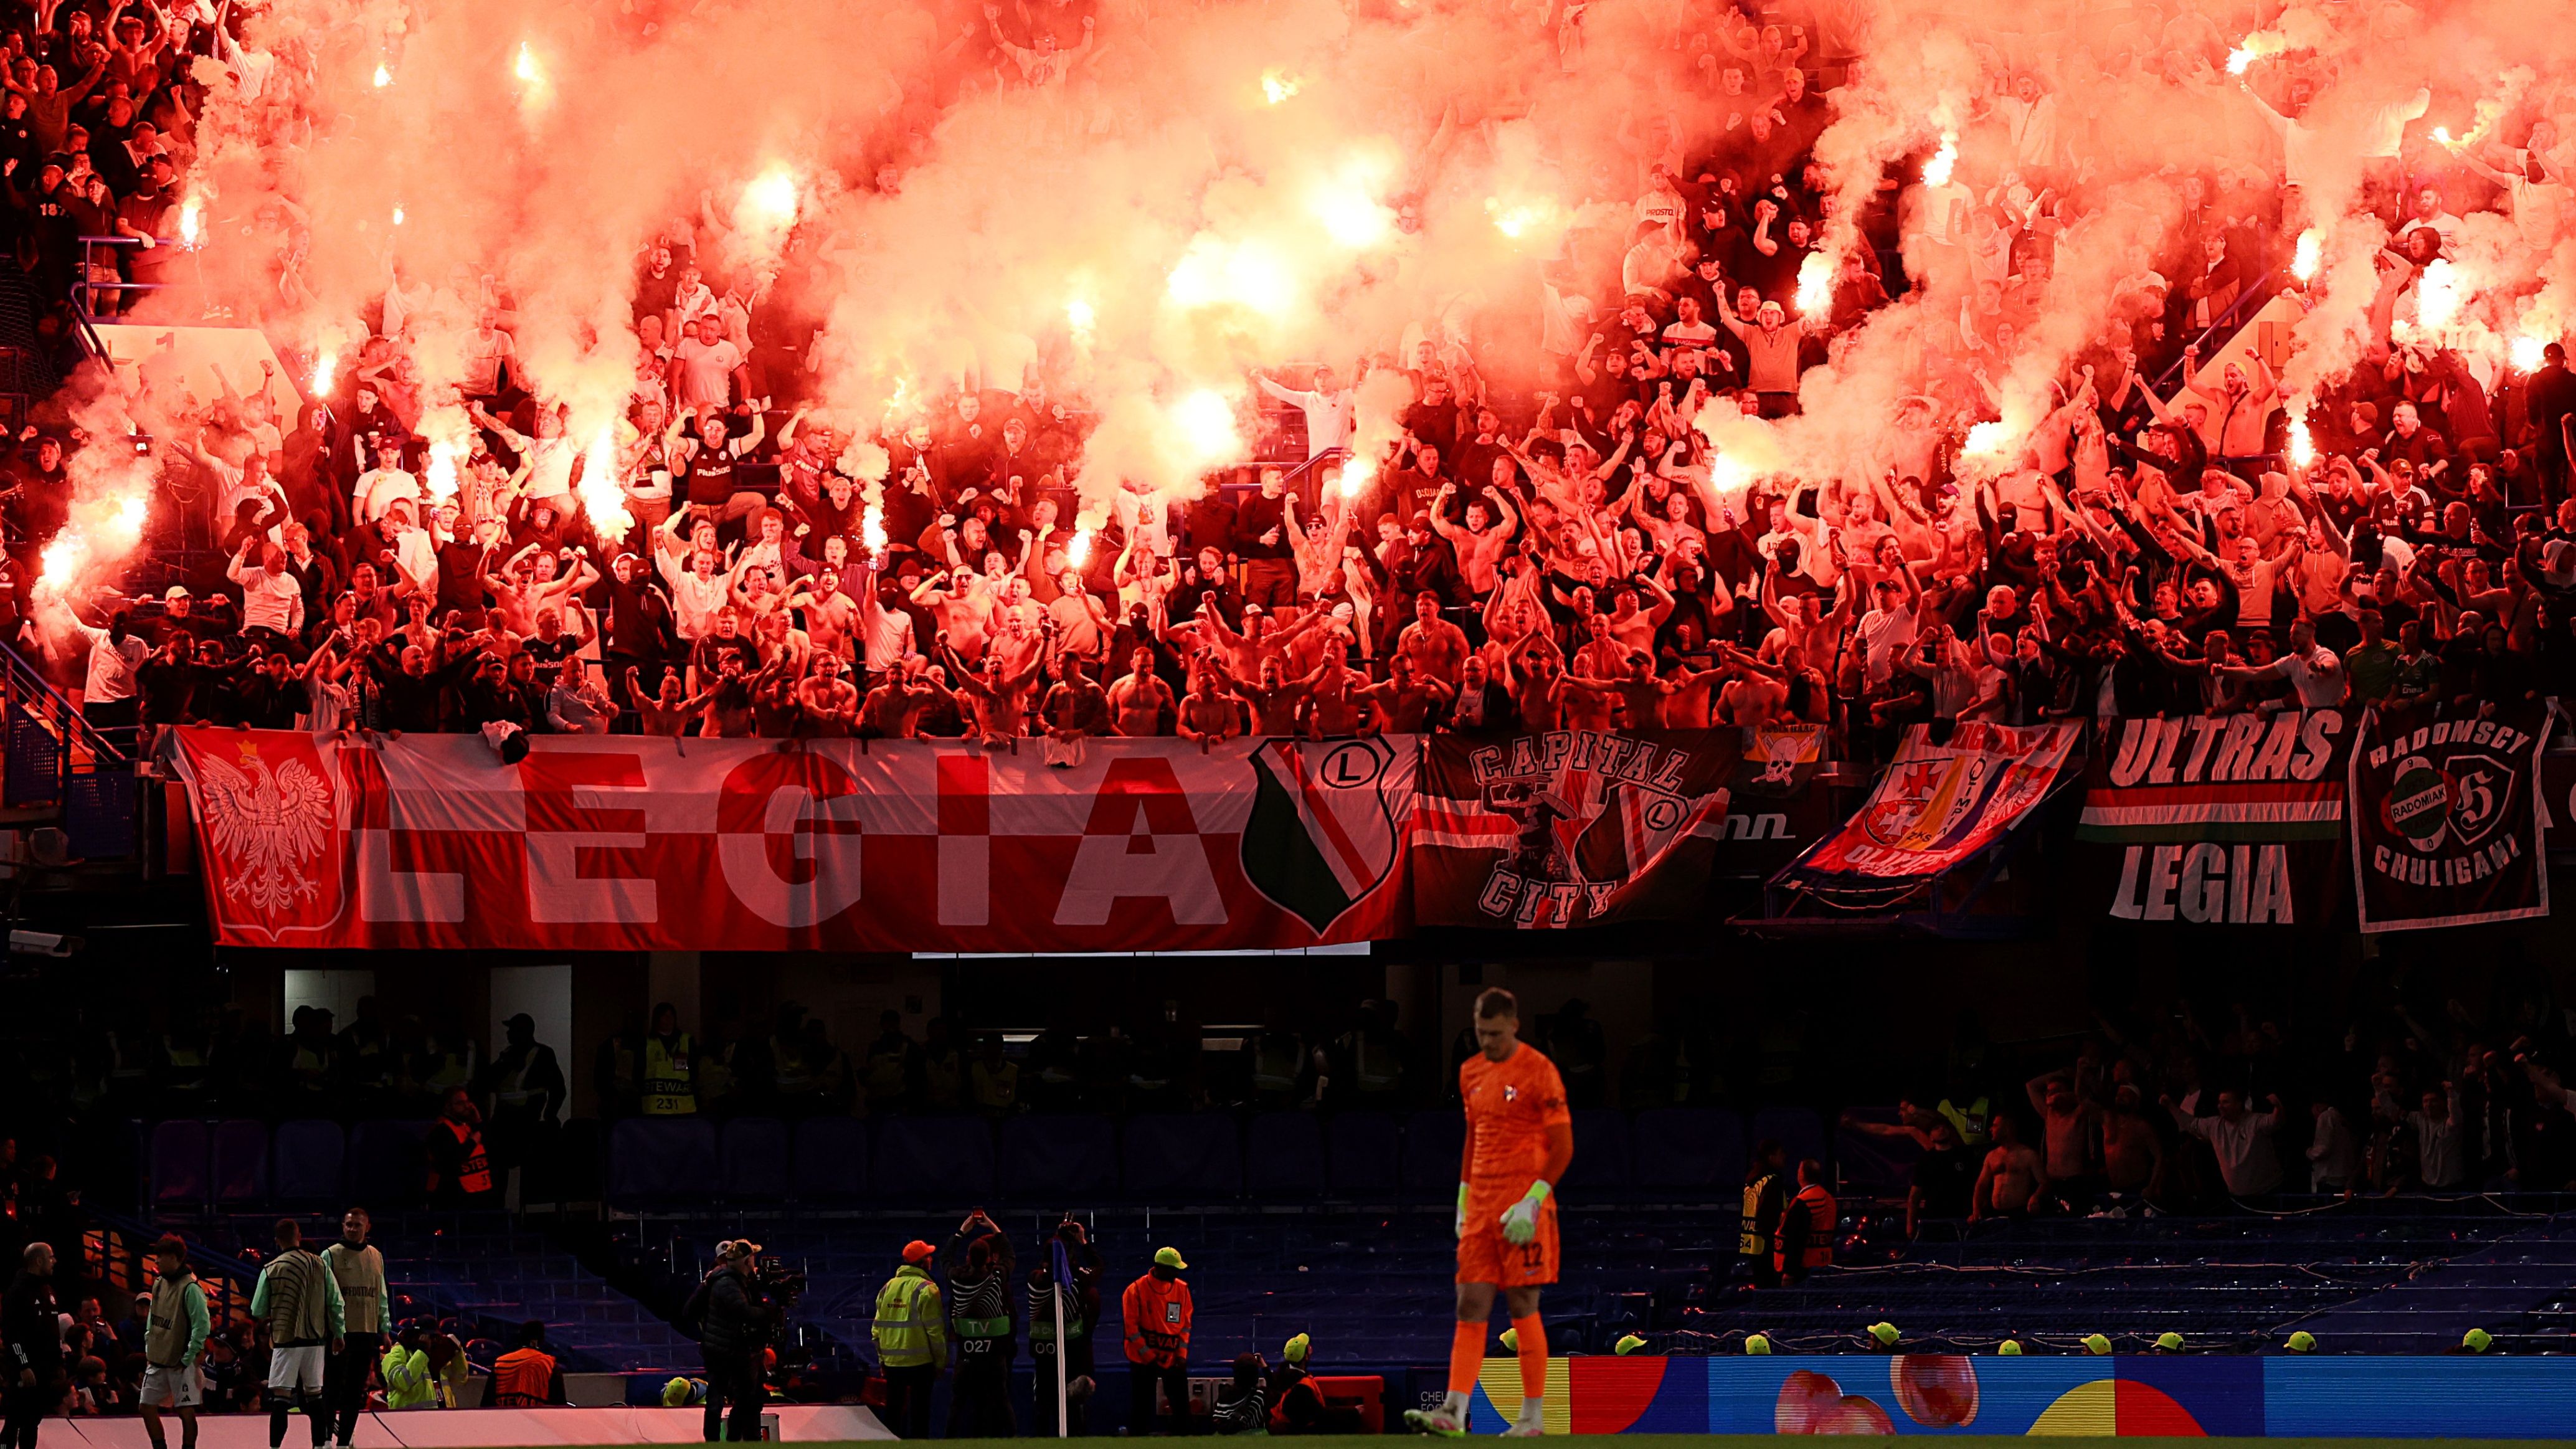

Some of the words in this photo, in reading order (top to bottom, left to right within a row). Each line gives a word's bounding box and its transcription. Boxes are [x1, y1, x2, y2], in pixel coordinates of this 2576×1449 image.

[697, 466, 731, 477] Plus500
[2110, 710, 2343, 787] ULTRAS
[2370, 720, 2531, 770] RADOMSCY
[1470, 730, 1689, 792] CAPITAL
[2393, 788, 2446, 819] RADOMIAK
[337, 746, 1228, 928] LEGIA
[1906, 831, 1932, 843] ZKS
[2375, 832, 2521, 887] CHULIGANI
[1479, 870, 1617, 924] CITY
[2110, 842, 2294, 923] LEGIA
[656, 1098, 679, 1110] 231
[1522, 1243, 1543, 1267] 12
[968, 1321, 990, 1333] TV
[964, 1339, 992, 1353] 027
[1421, 1390, 1446, 1402] CHEL
